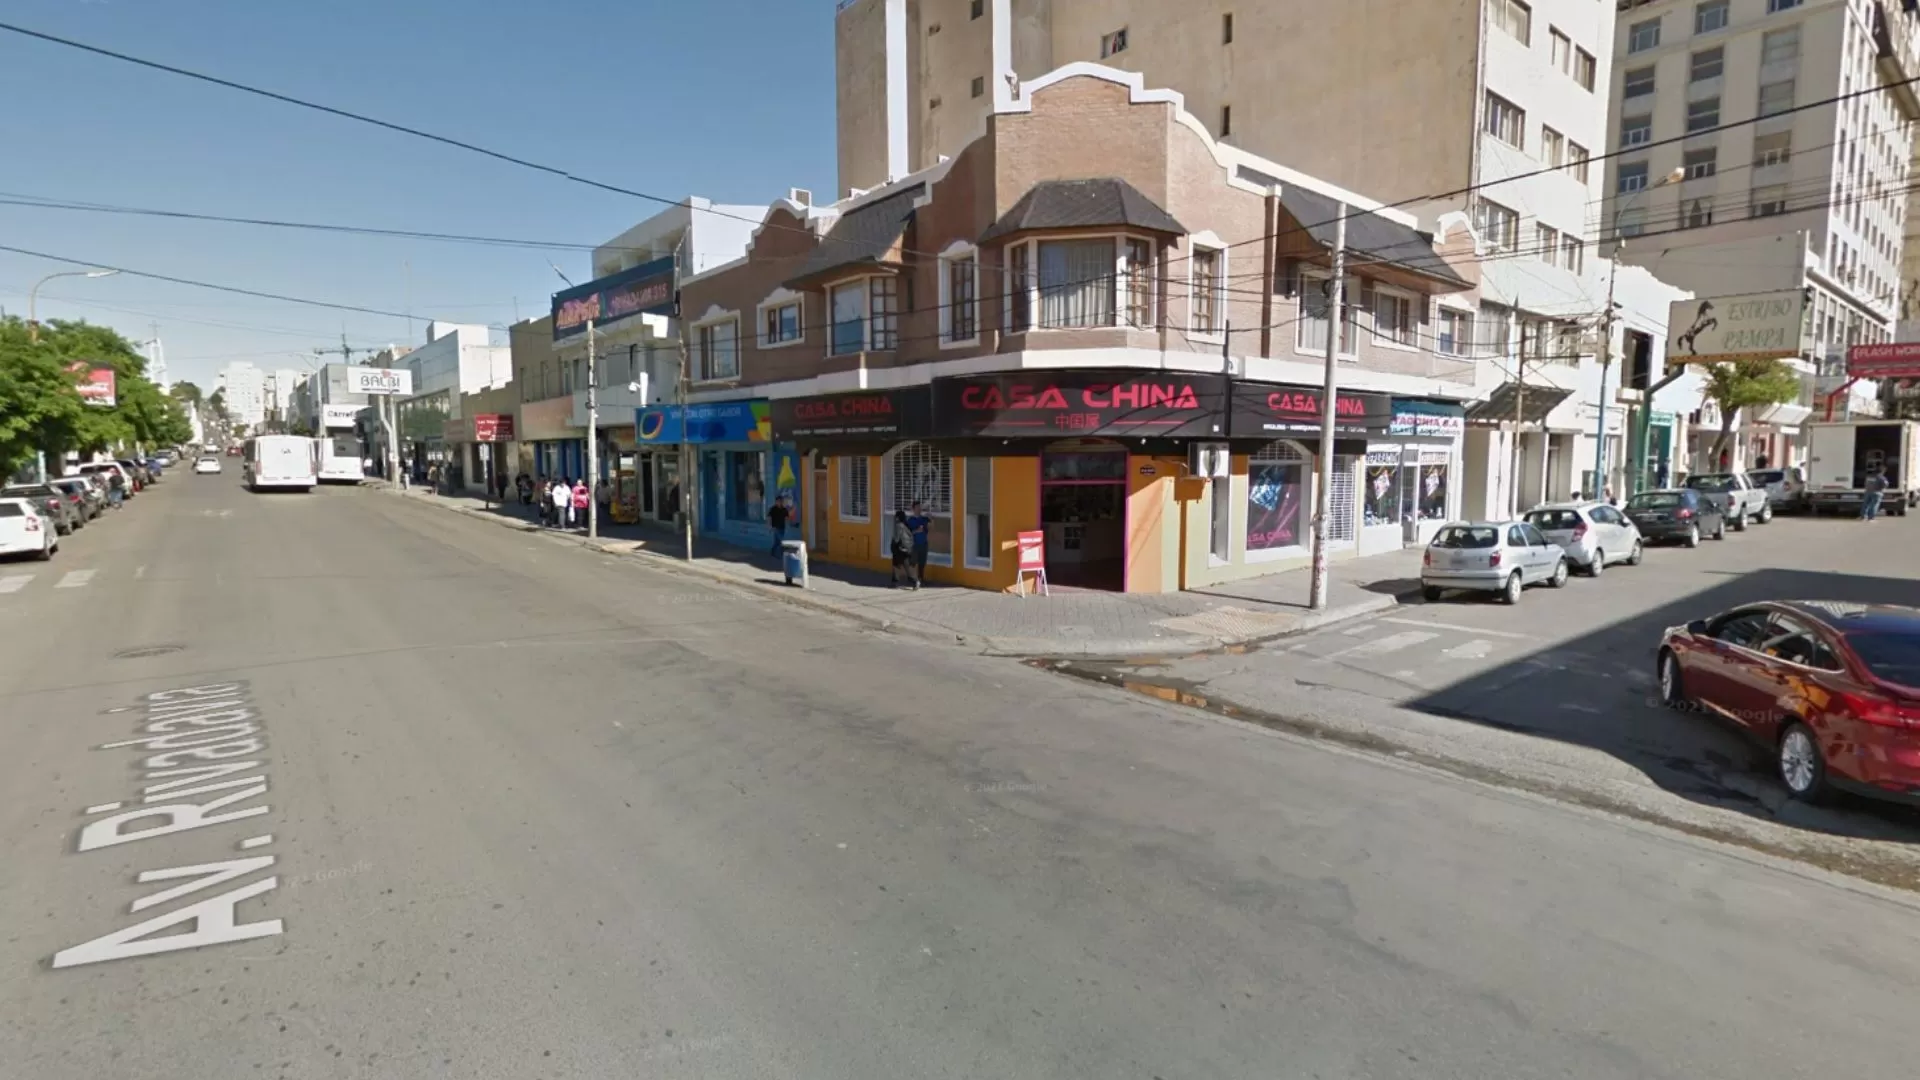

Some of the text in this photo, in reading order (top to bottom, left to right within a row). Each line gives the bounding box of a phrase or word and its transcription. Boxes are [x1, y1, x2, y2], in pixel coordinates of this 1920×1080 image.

[1727, 298, 1792, 321] ESTRIBO
[1723, 327, 1785, 351] PAMPA
[360, 375, 400, 387] BALBI
[794, 396, 893, 419] CASA CHINA
[961, 383, 1199, 410] CASA CHINA
[1267, 392, 1366, 415] CASA HINA
